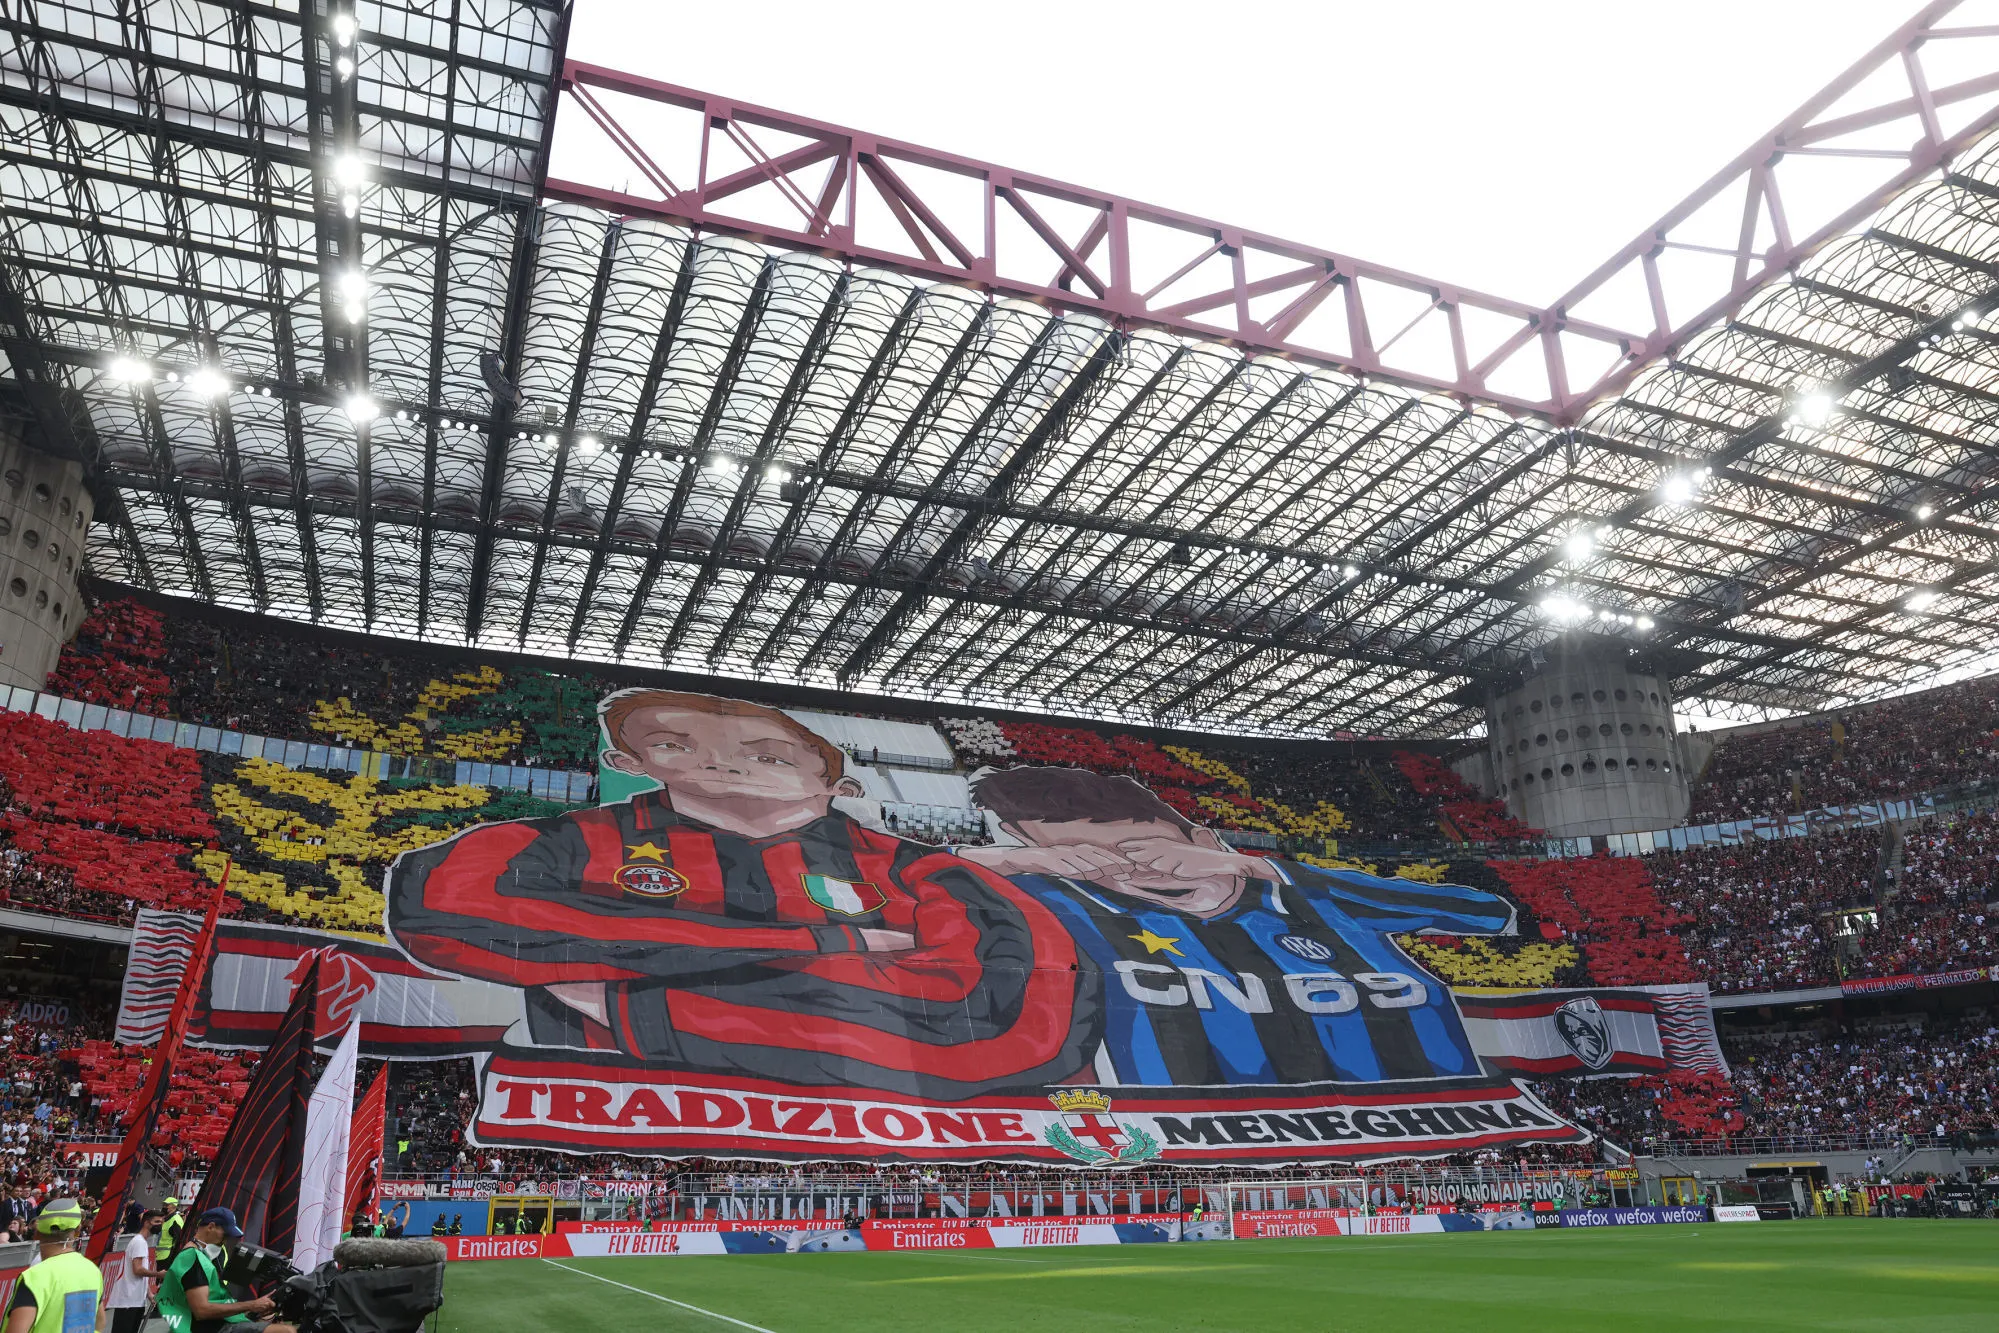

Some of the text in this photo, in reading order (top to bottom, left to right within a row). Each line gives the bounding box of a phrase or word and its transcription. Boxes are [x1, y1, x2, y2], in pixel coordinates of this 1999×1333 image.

[1842, 978, 1914, 995] MILAN CLUB ALASSIO
[1924, 971, 1980, 987] PERINALDO
[496, 1080, 1553, 1146] TRADIZIONE MENEGHINA
[1256, 1221, 1318, 1237] Emirates
[1380, 1217, 1410, 1232] BETTER
[1535, 1215, 1560, 1225] 00:00
[1567, 1207, 1702, 1227] wefox wefox wefox
[457, 1234, 678, 1257] Emirates FLY BETTER
[893, 1227, 1079, 1248] Emirates FLY BETTER
